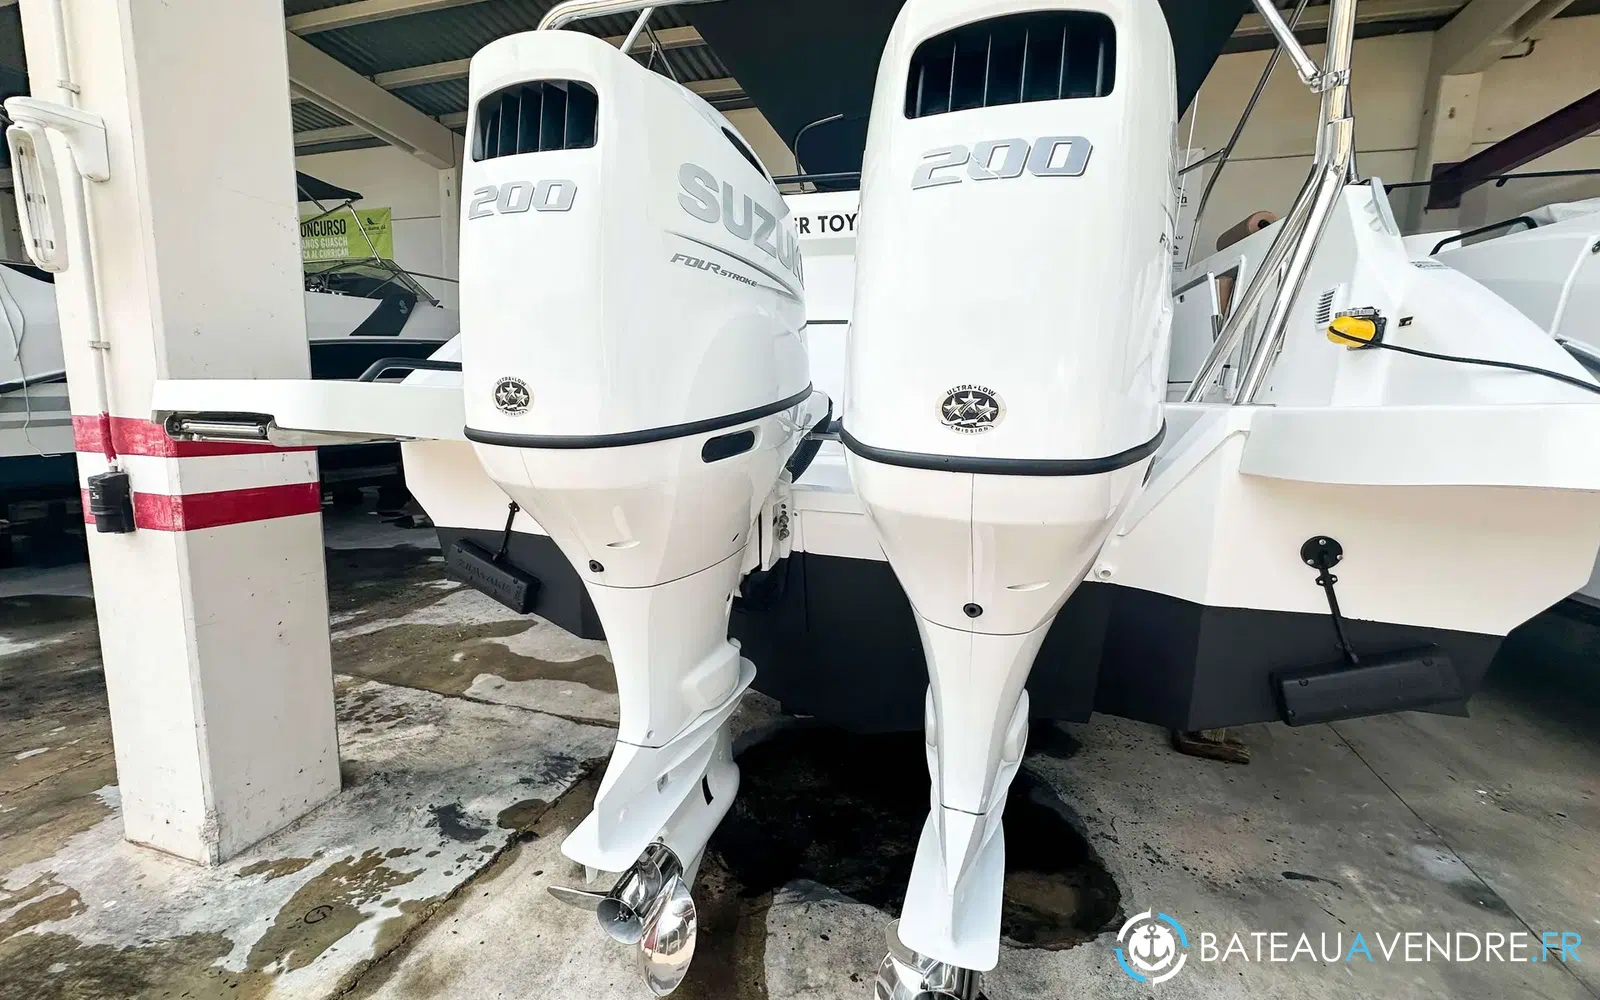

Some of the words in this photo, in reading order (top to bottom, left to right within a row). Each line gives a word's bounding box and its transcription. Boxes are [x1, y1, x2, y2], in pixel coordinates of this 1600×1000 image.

[911, 136, 1093, 190] 200
[468, 179, 578, 220] 200
[817, 213, 858, 233] TOY
[670, 253, 721, 274] FOUR
[719, 269, 758, 288] STROKE
